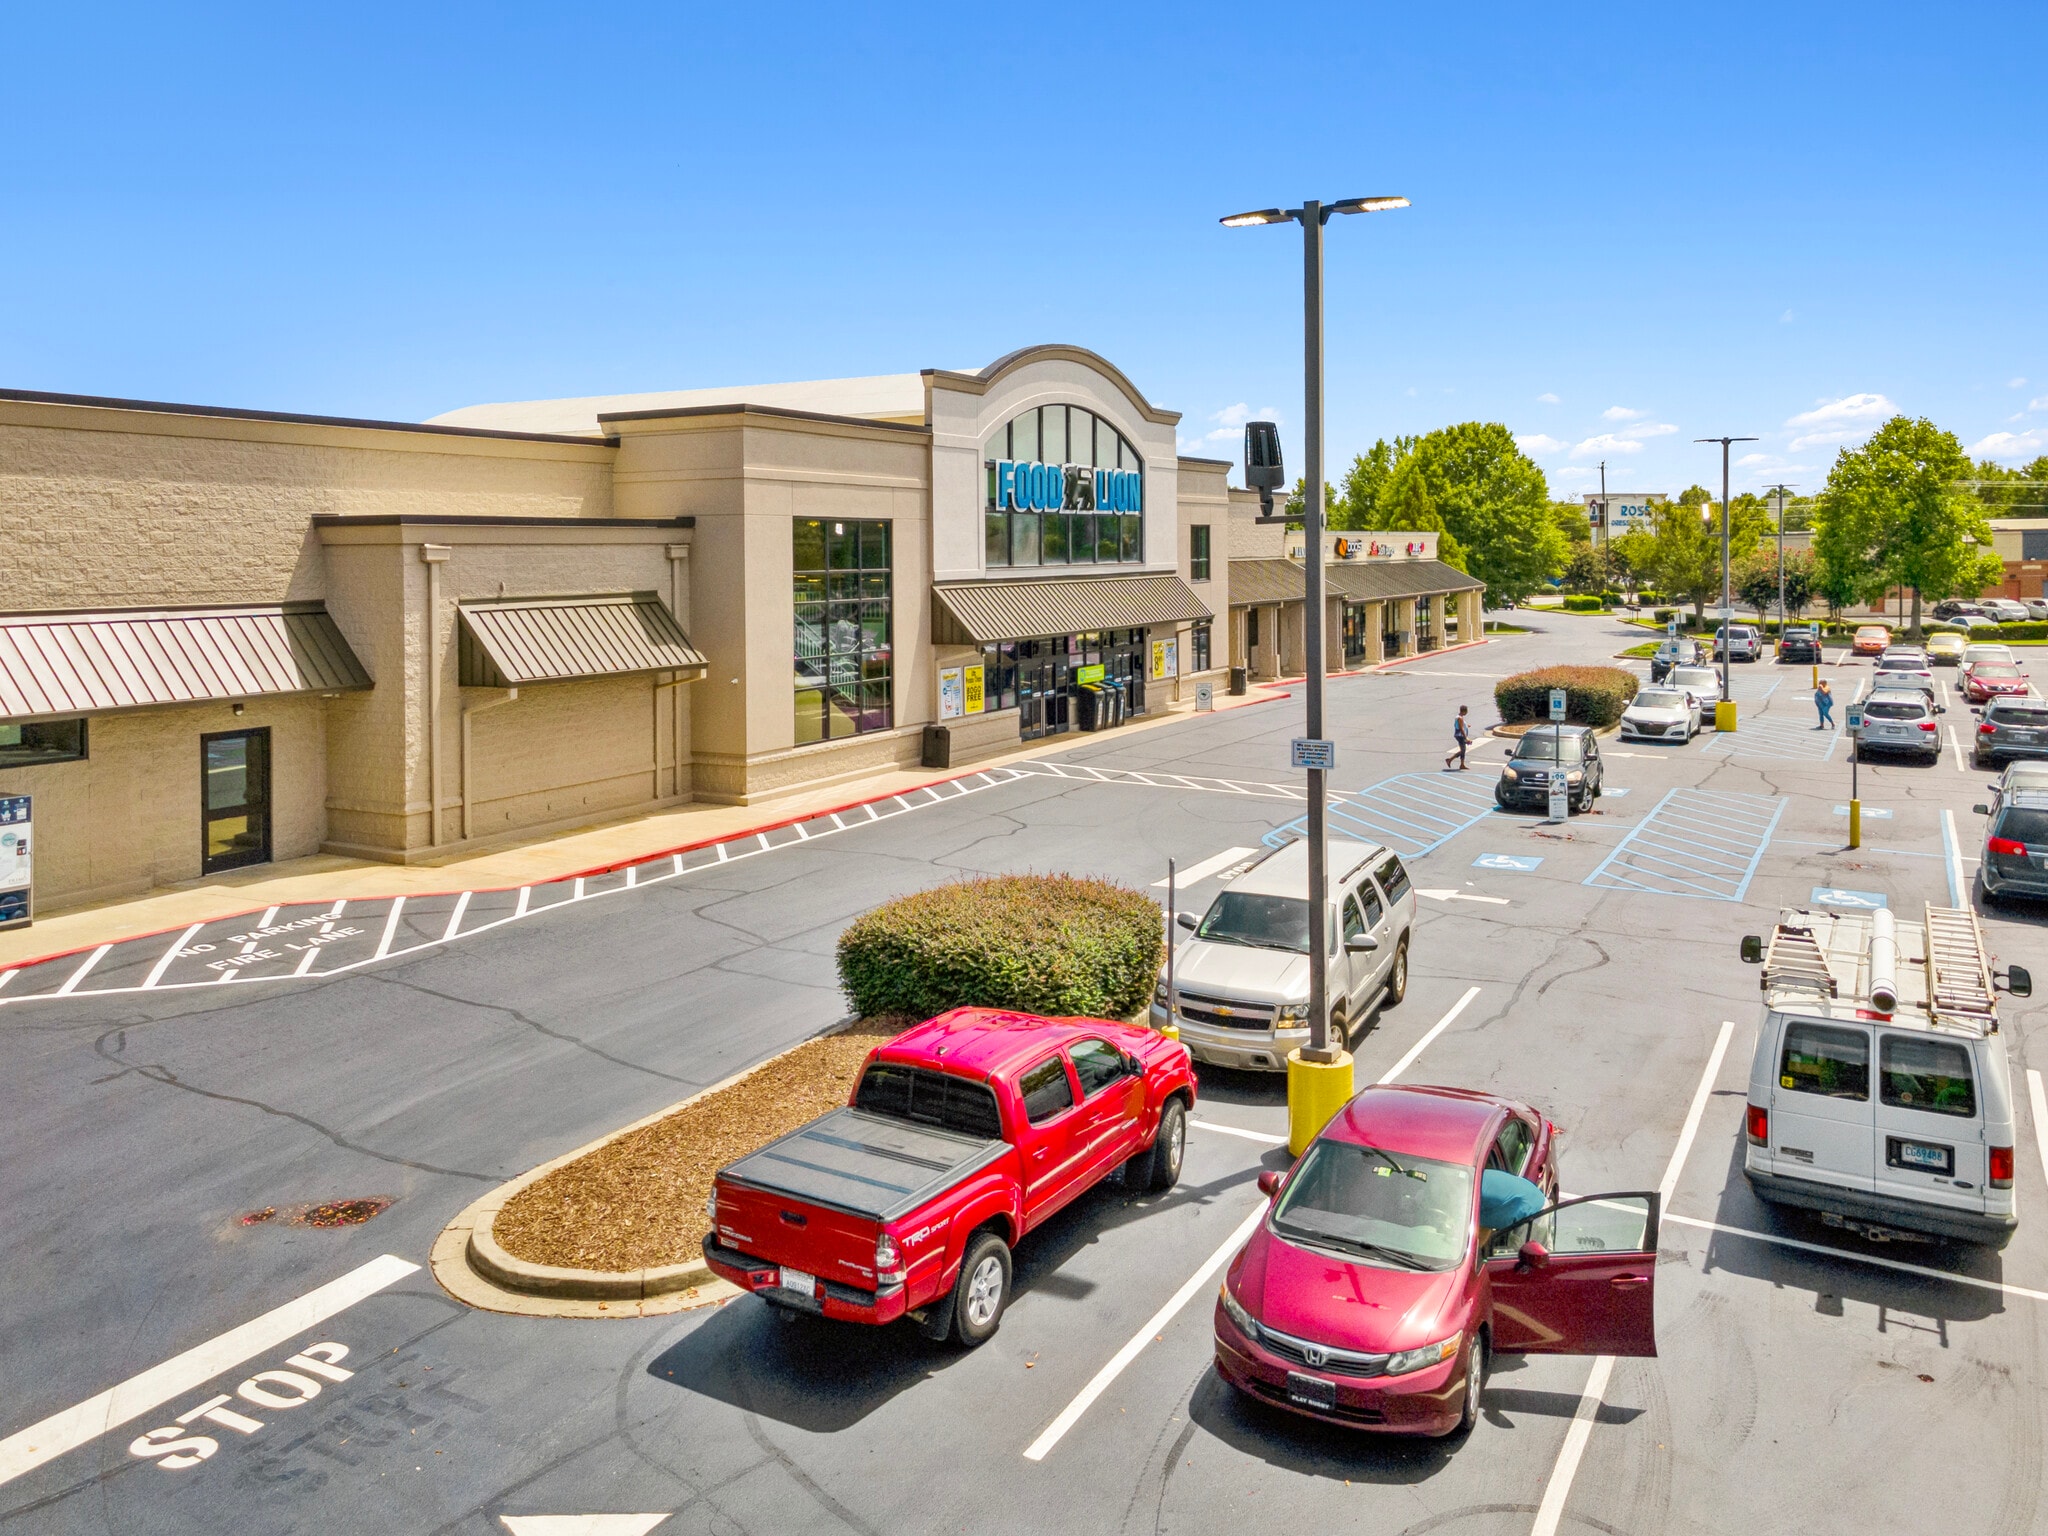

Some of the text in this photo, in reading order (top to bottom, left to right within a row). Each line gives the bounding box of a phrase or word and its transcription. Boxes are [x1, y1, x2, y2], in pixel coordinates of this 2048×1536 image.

[997, 460, 1142, 513] FOOD LION
[966, 685, 982, 695] BOGO
[966, 694, 982, 702] FREE
[176, 913, 342, 958] NO PARKING
[206, 926, 365, 971] FIRE LANE
[902, 1216, 950, 1247] TRD SPORT
[129, 1341, 355, 1470] STOP
[1291, 1394, 1308, 1404] PLAY
